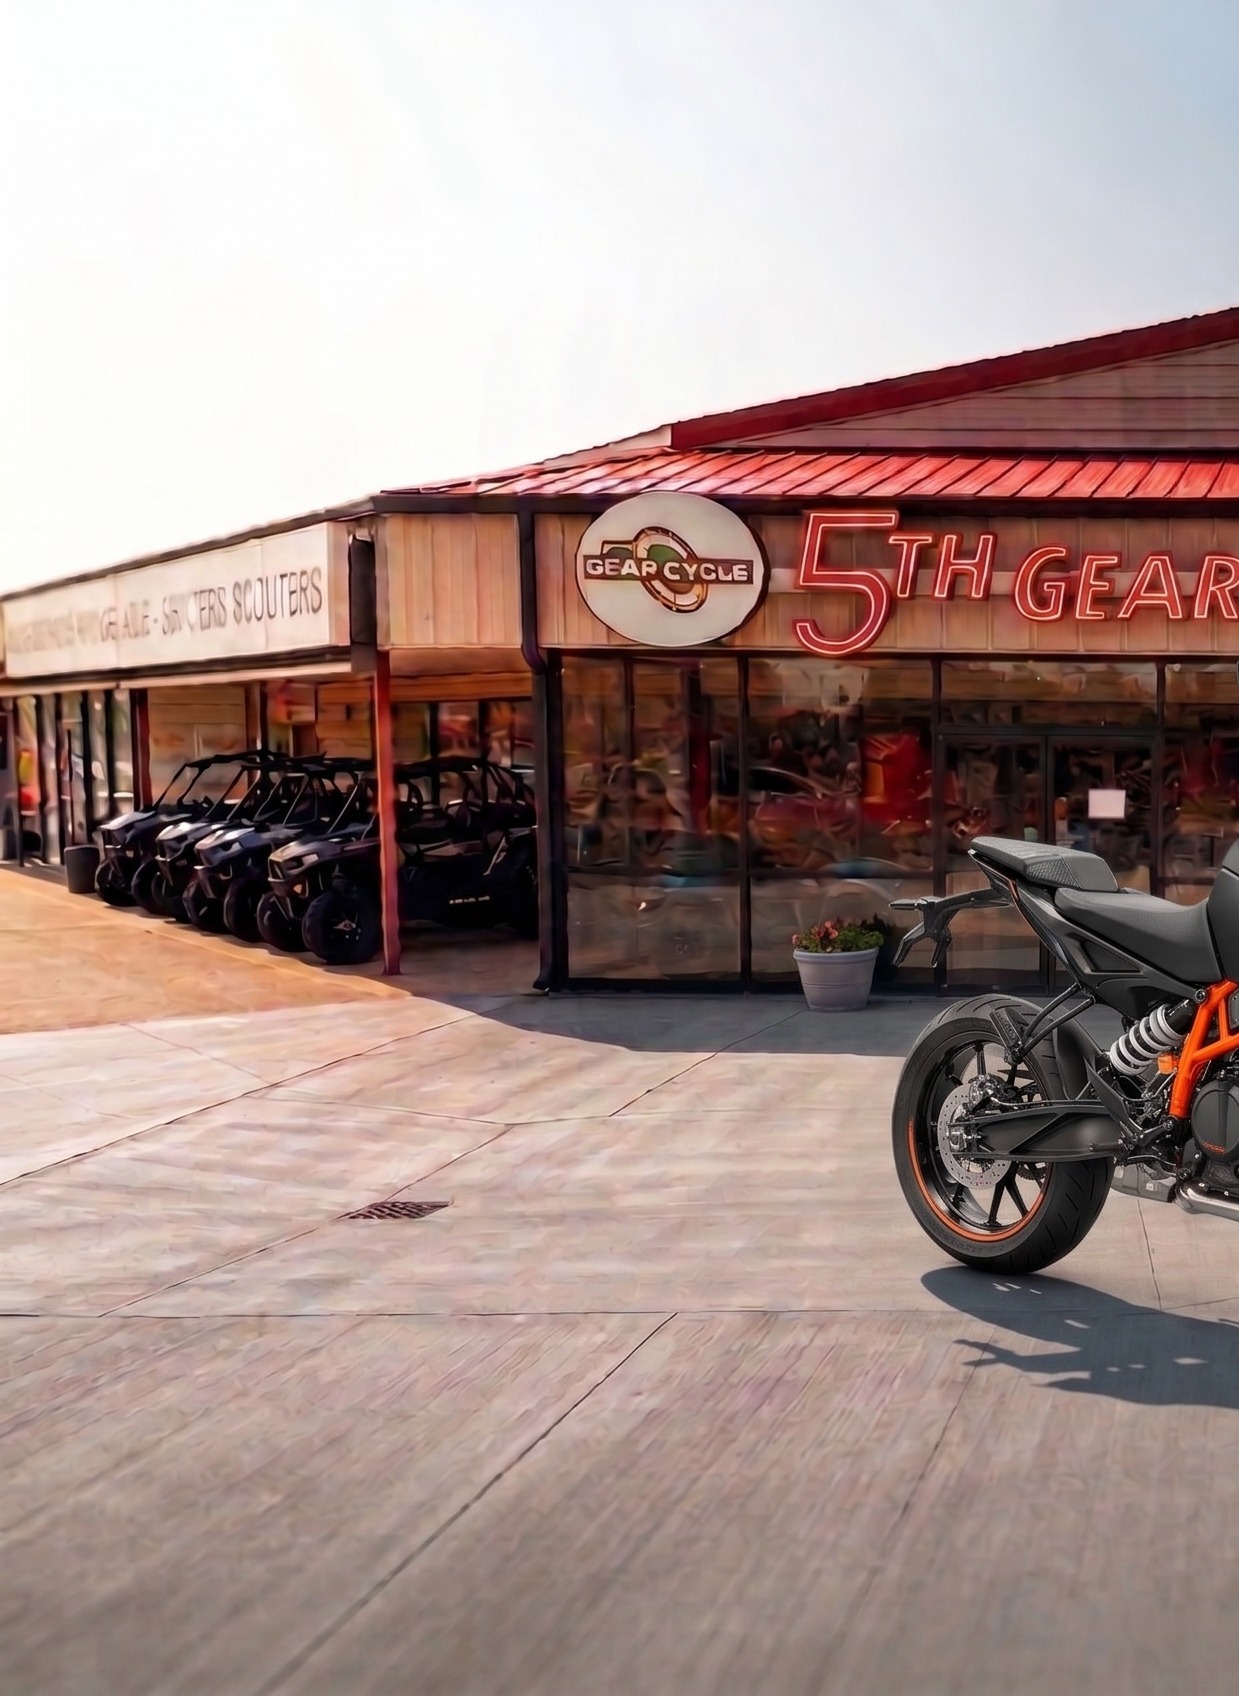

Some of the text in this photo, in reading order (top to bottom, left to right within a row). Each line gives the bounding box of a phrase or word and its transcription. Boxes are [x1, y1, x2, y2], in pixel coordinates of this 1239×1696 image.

[585, 558, 749, 582] GEAR CYCLE
[793, 508, 997, 657] 5TH
